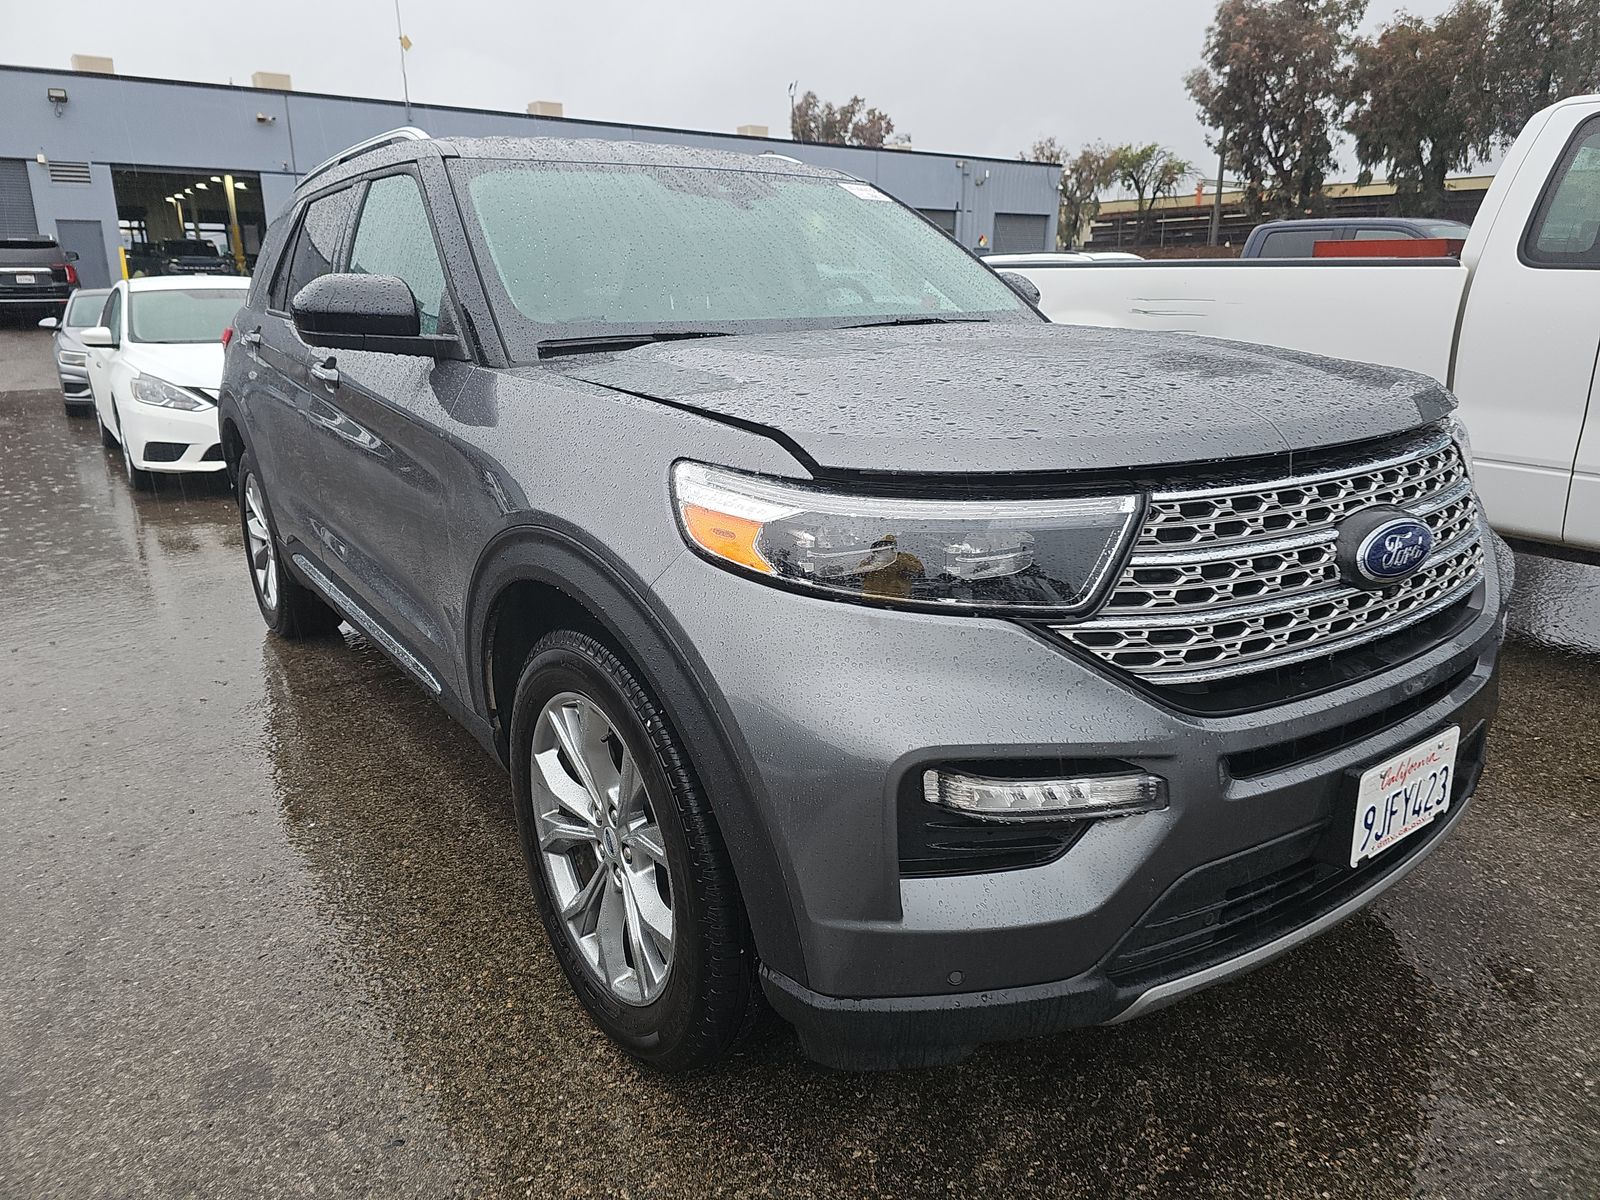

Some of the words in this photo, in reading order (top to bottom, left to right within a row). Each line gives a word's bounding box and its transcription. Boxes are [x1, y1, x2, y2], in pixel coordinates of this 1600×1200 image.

[1382, 531, 1424, 569] Ford
[1380, 752, 1440, 790] California
[1360, 765, 1449, 852] 9JFY423
